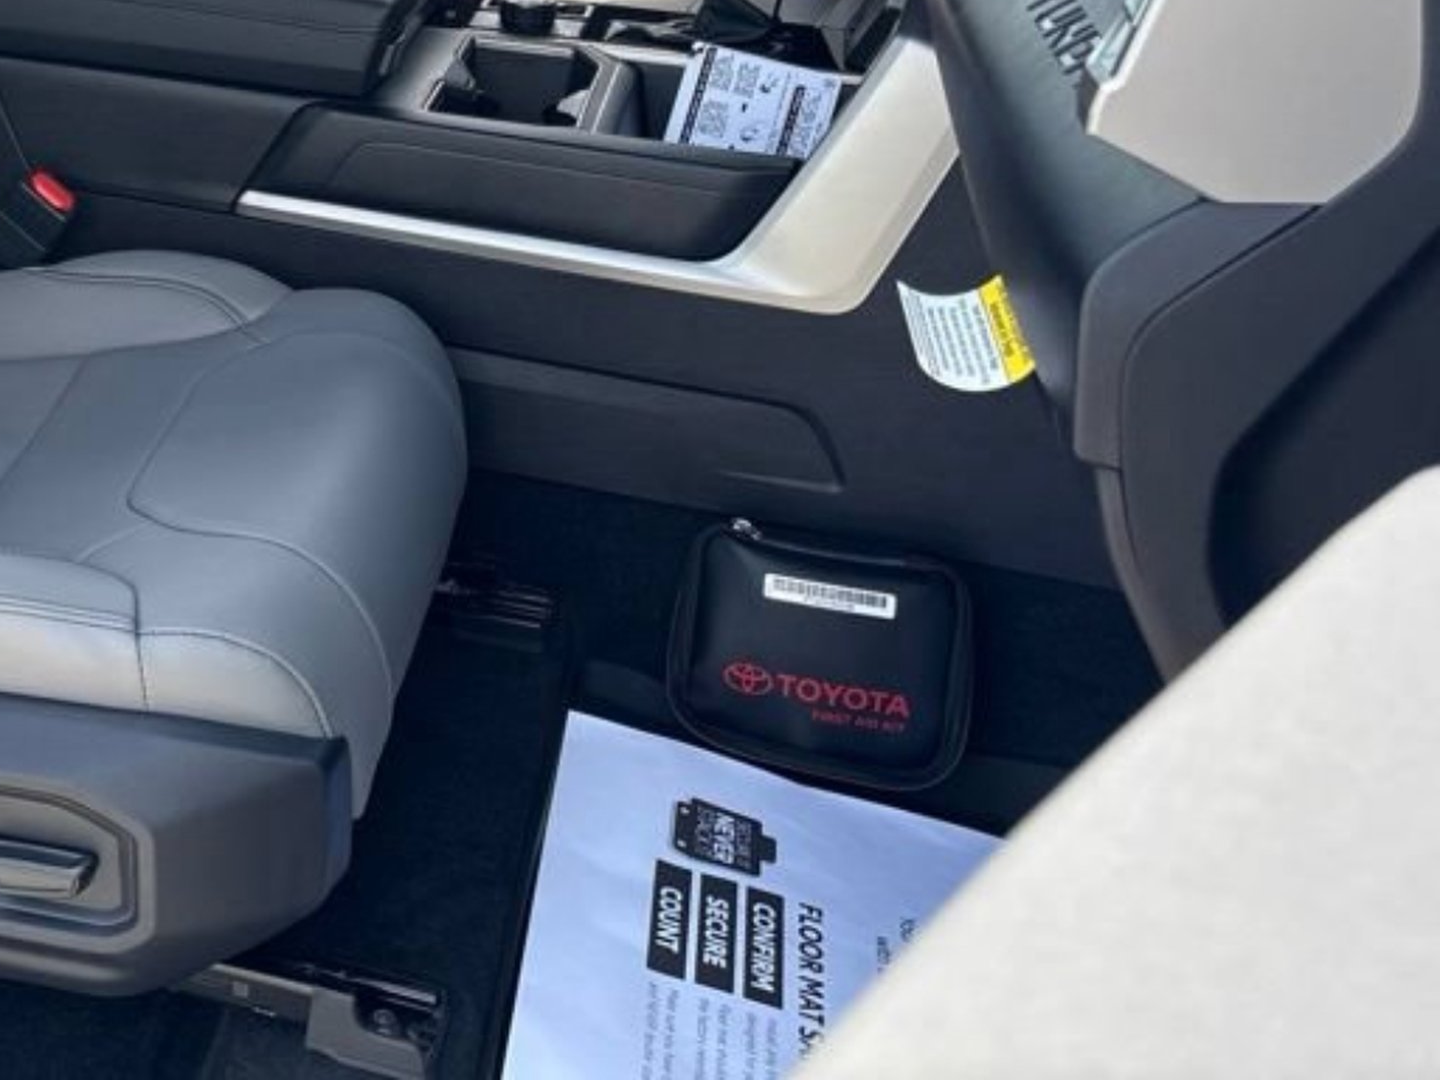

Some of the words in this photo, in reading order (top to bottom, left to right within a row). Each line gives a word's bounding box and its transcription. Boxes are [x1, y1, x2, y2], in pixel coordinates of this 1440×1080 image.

[775, 672, 910, 719] TOYOTA
[714, 812, 736, 865] NEVER
[655, 886, 684, 955] COUNT
[702, 895, 730, 969] SECURE
[749, 901, 777, 994] CONFIRM
[797, 901, 825, 974] FLOOR
[797, 975, 826, 1027] MAT
